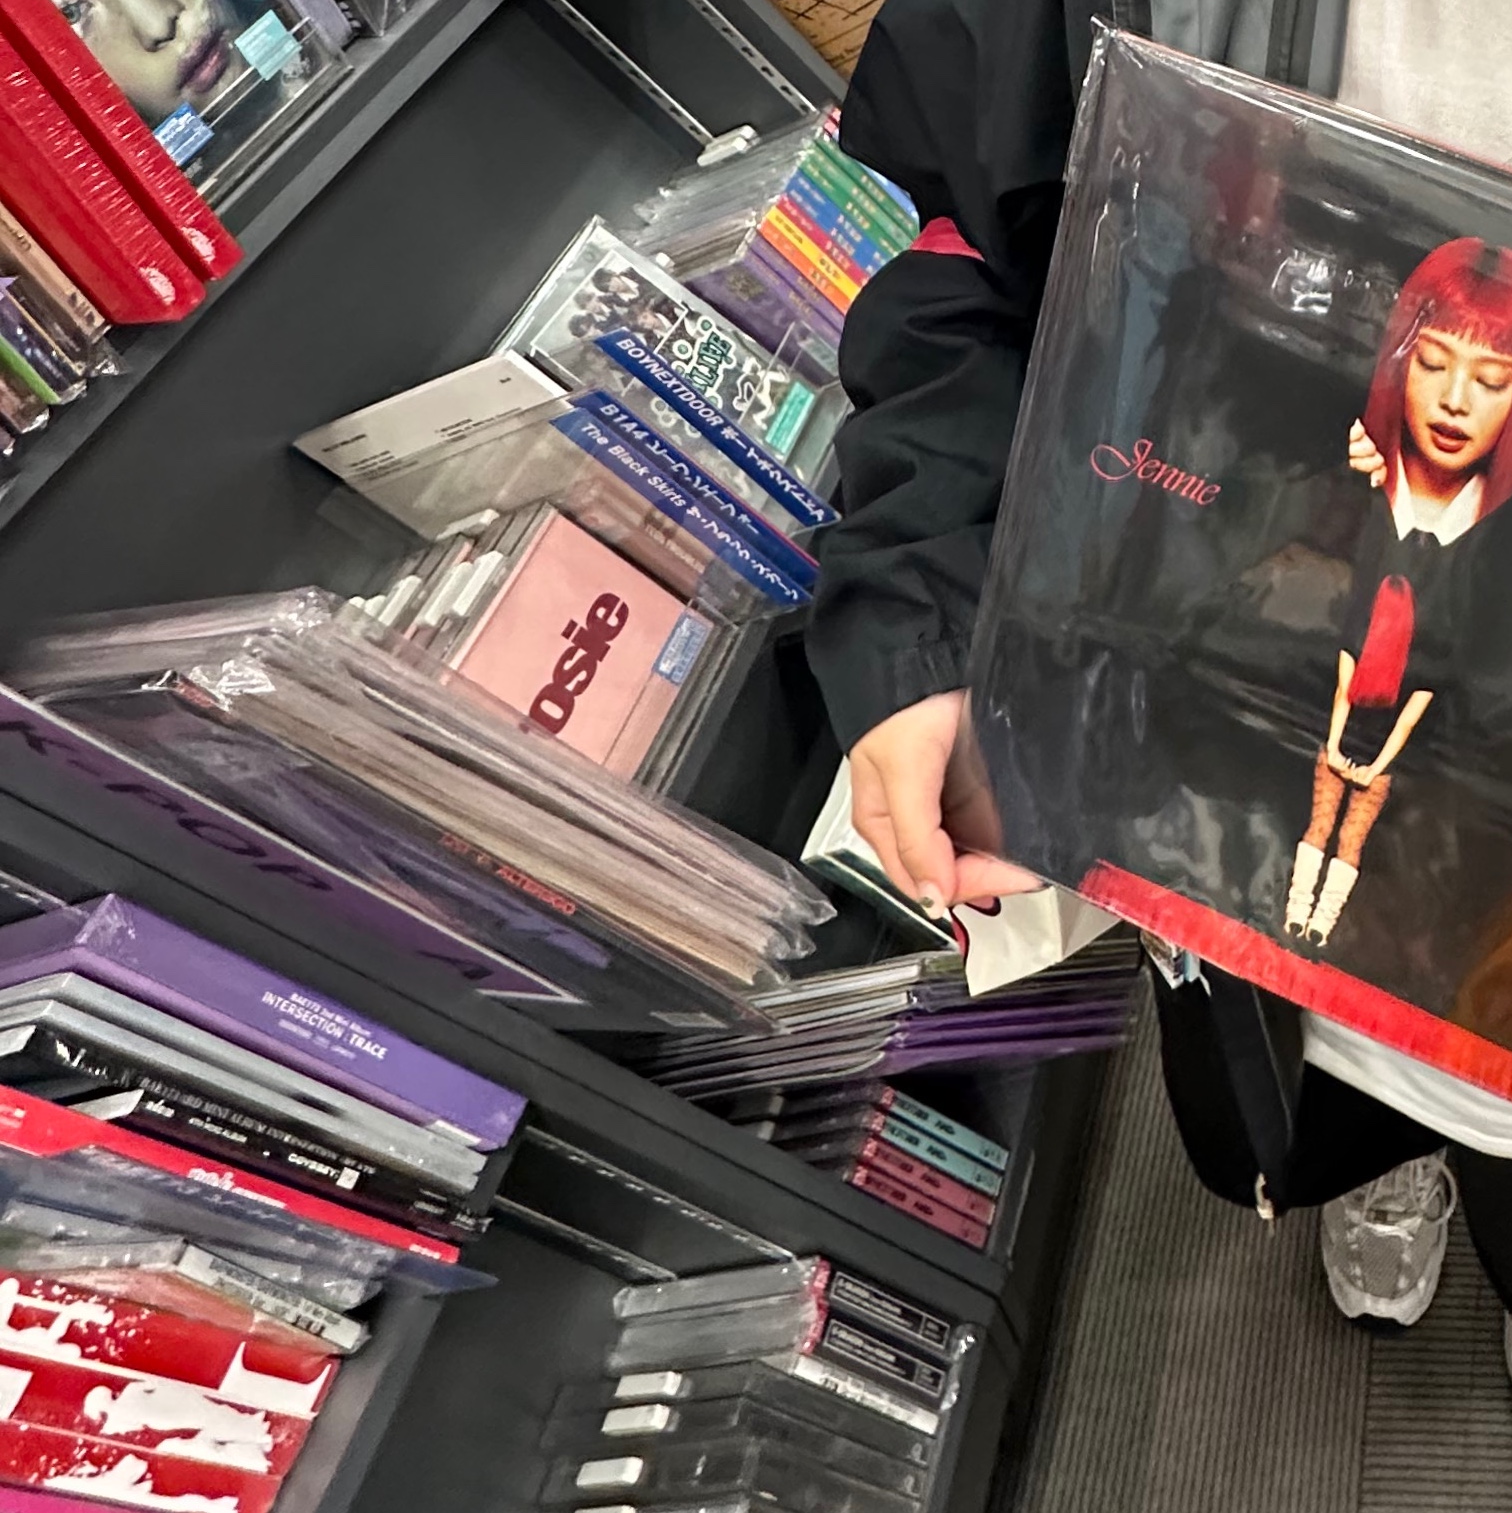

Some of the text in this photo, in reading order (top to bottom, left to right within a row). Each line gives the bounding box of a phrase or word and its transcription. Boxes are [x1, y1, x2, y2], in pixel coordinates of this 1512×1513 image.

[615, 337, 721, 427] BOYNEXTDOOR
[598, 403, 649, 442] B1A4
[581, 422, 608, 447] The
[608, 440, 649, 477] Black
[648, 476, 687, 507] Skirts
[1090, 438, 1222, 506] Jennie
[518, 592, 631, 736] osie
[262, 991, 343, 1038] INTERSECTION
[349, 1033, 388, 1060] TRACE
